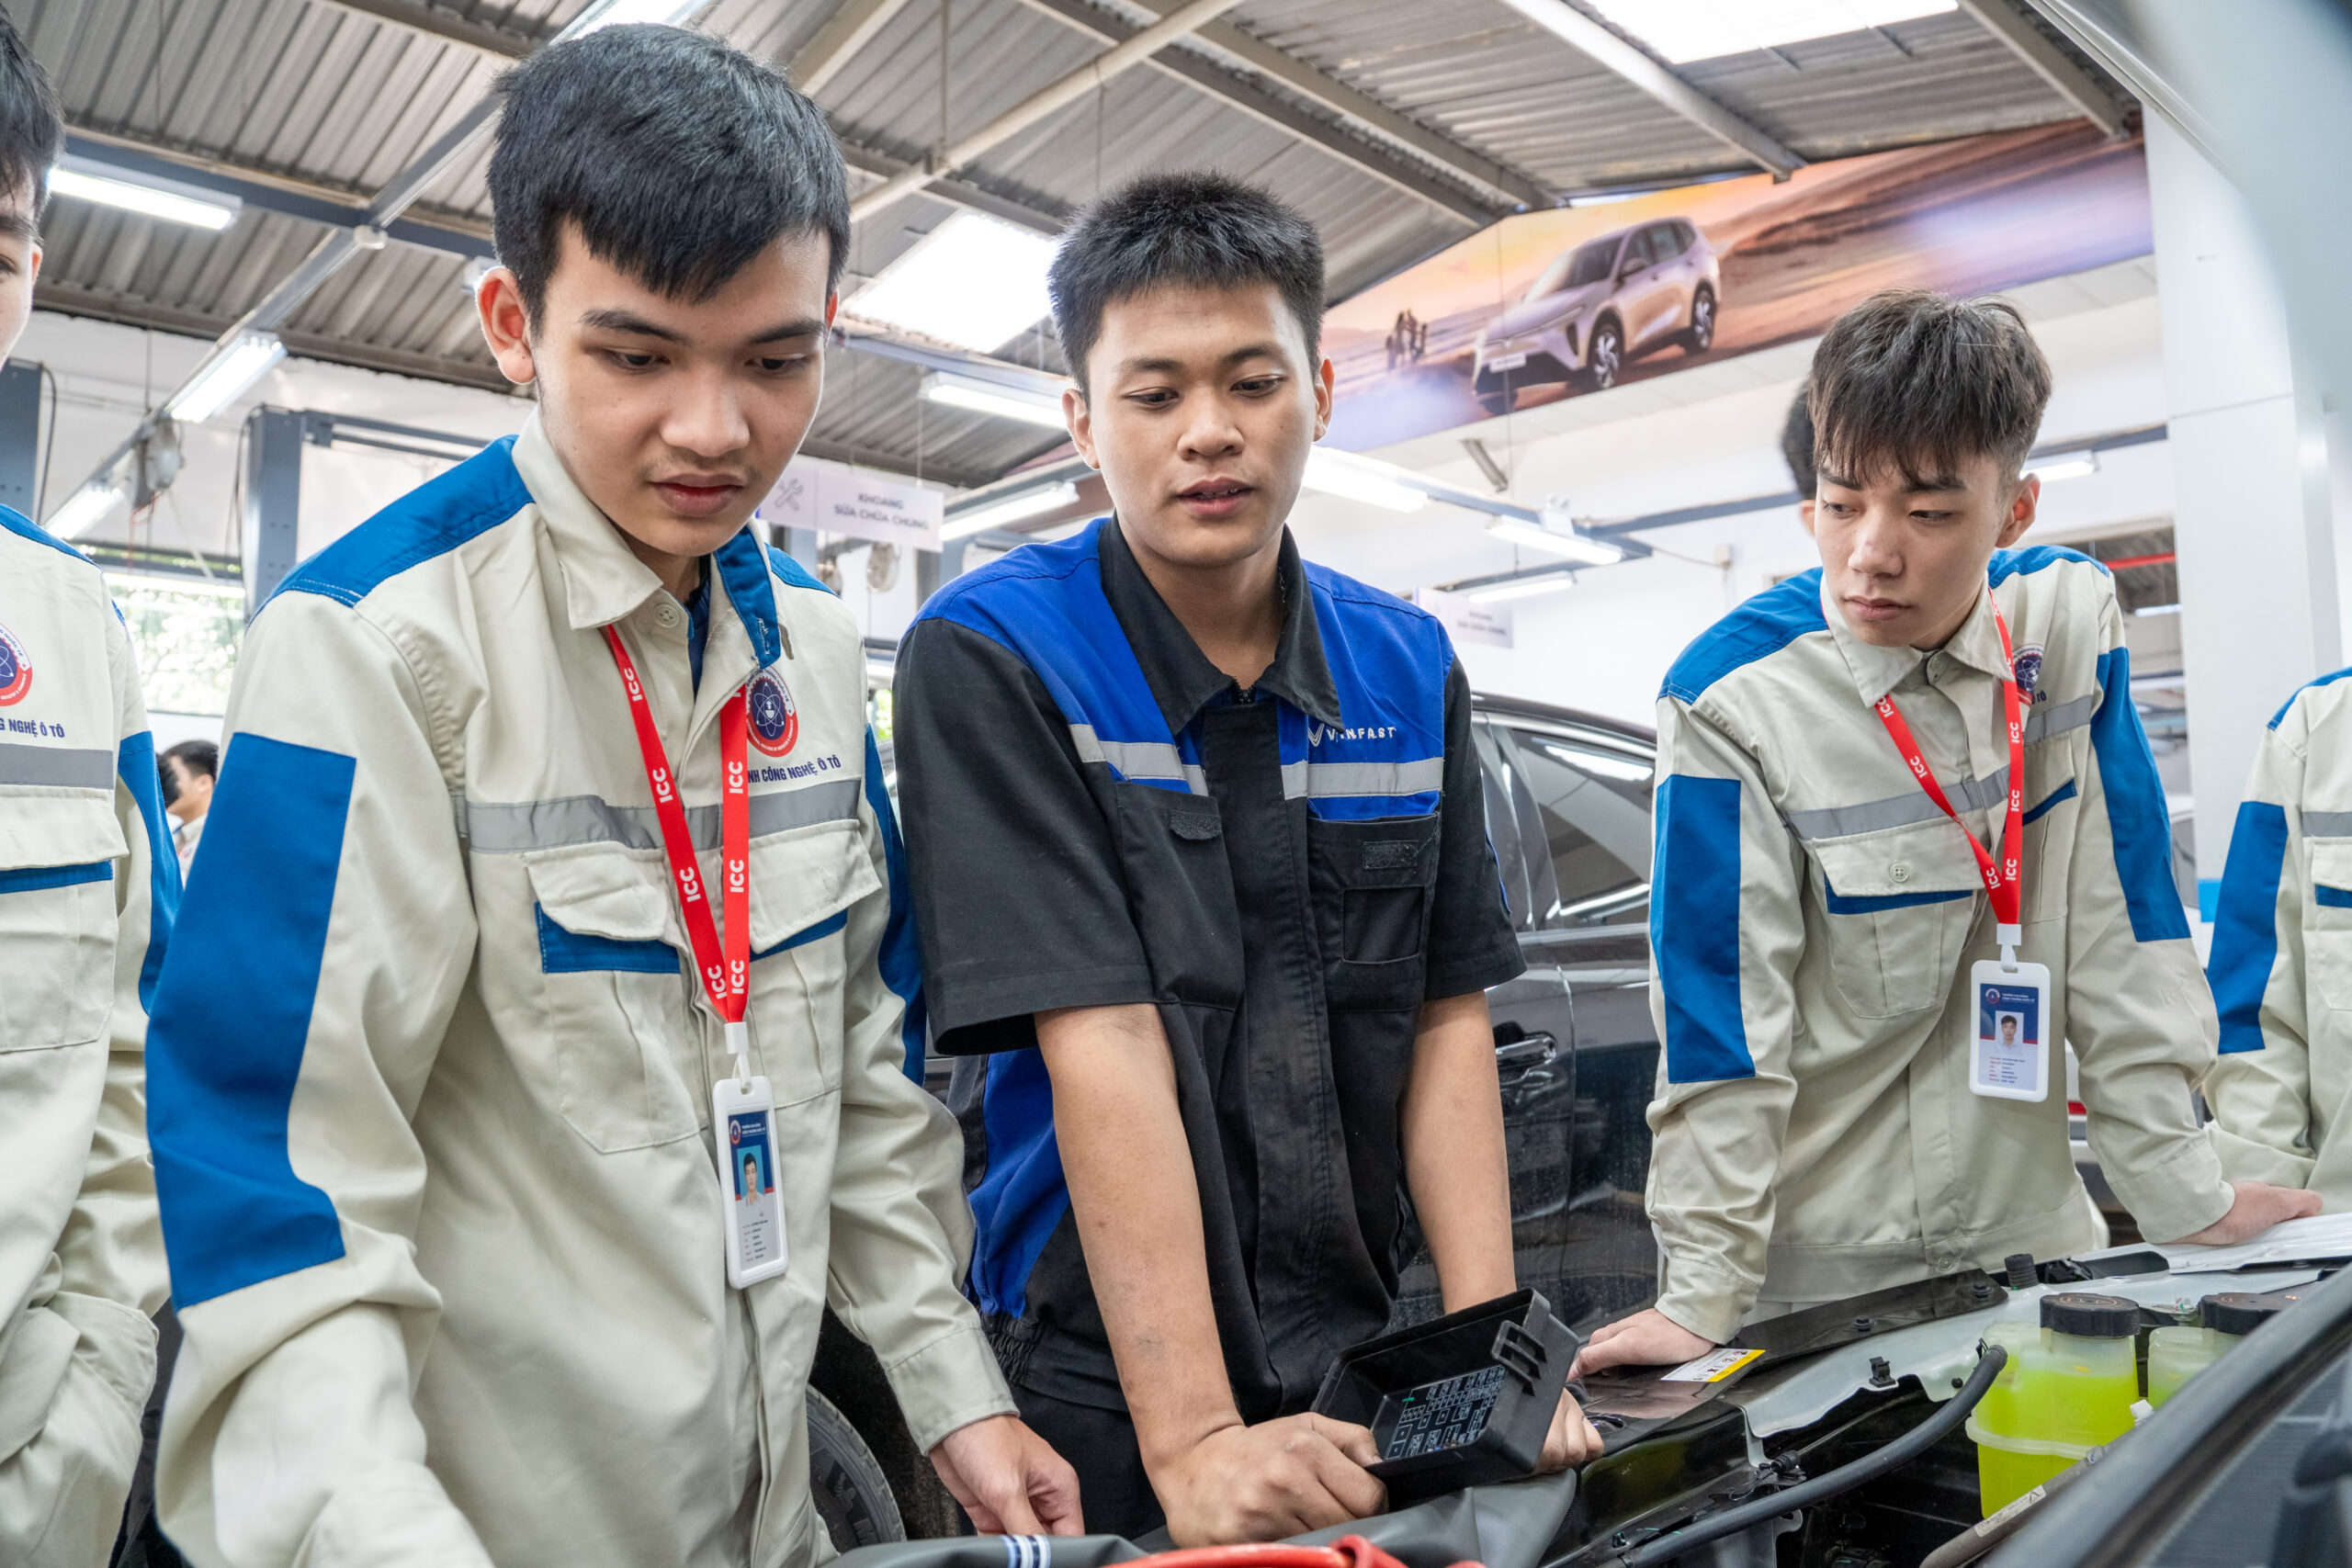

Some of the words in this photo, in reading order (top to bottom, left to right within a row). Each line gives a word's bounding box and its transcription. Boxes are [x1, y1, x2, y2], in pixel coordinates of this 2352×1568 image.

[624, 667, 643, 702] ICC
[8, 718, 38, 738] NGHỆ
[40, 721, 48, 737] Ô
[49, 723, 65, 739] TÔ
[2009, 721, 2019, 744] ICC
[728, 761, 743, 795] ICC
[762, 766, 787, 783] CÔNG
[788, 761, 818, 780] NGHỆ
[818, 757, 828, 772] Ô
[827, 754, 842, 769] TÔ
[1909, 755, 1928, 778] ICC
[652, 766, 673, 803] ICC
[2010, 789, 2020, 812] ICC
[679, 866, 701, 903] ICC
[729, 859, 744, 893] ICC
[1985, 866, 2001, 890] ICC
[2005, 858, 2018, 881] ICC
[707, 964, 728, 999] ICC
[730, 959, 745, 994] ICC
